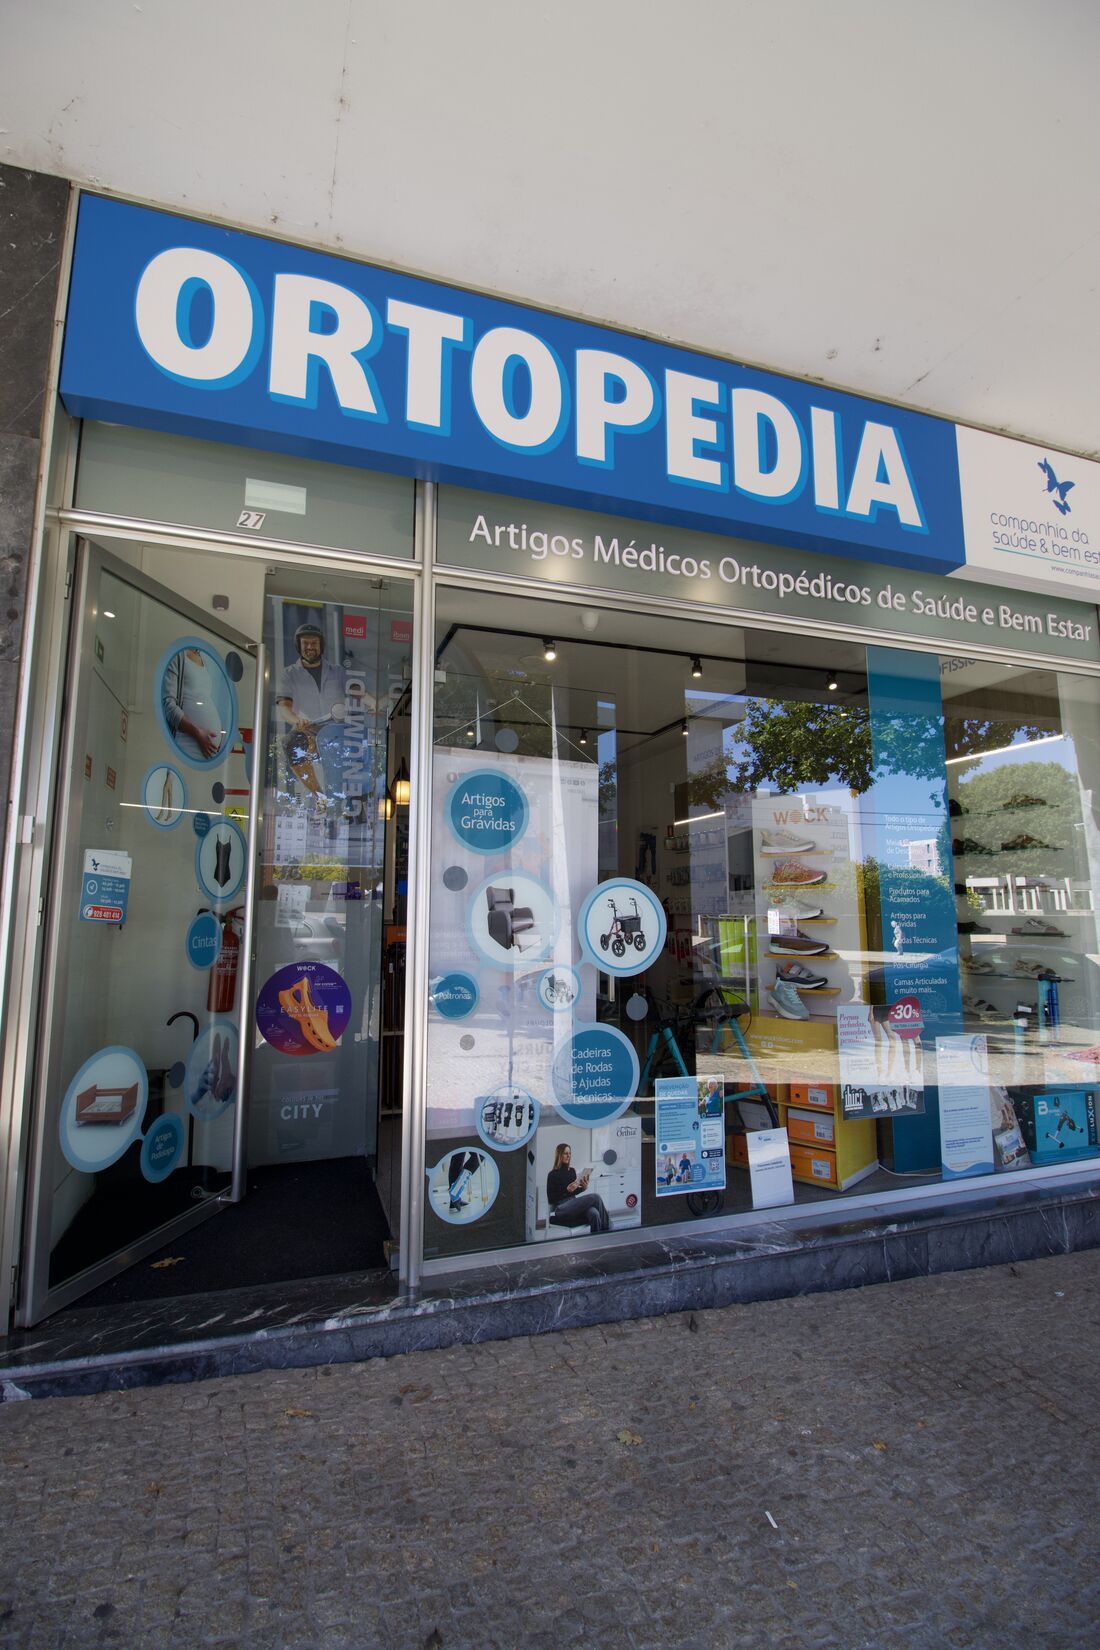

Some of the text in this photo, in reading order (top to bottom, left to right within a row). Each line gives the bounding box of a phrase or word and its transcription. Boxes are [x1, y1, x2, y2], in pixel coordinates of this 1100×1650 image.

[134, 246, 927, 533] ORTOPEDIA
[239, 512, 264, 528] 27
[990, 513, 1090, 545] companhia da
[992, 531, 1037, 551] saúde
[1039, 538, 1048, 553] &
[1051, 540, 1081, 560] bem
[469, 514, 1092, 642] Artigos Médicos Ortopédicos de Saúde e Bem Estar
[345, 625, 364, 635] medi
[461, 792, 506, 809] Artigos
[473, 807, 493, 817] para
[461, 816, 516, 831] Grávidas
[889, 887, 930, 897] Produtos para
[890, 912, 912, 921] Artigos
[192, 935, 217, 950] Cintas
[914, 936, 937, 944] Técnicas
[894, 977, 947, 986] Camas Articuladas
[438, 992, 472, 1000] Poltronas
[900, 986, 917, 994] muito
[891, 1004, 919, 1019] -30%
[571, 1048, 612, 1059] Cadeiras
[571, 1062, 613, 1074] de Rodas
[571, 1077, 611, 1089] e Ajudas
[572, 1090, 613, 1104] Técnicas
[280, 1103, 323, 1120] CITY
